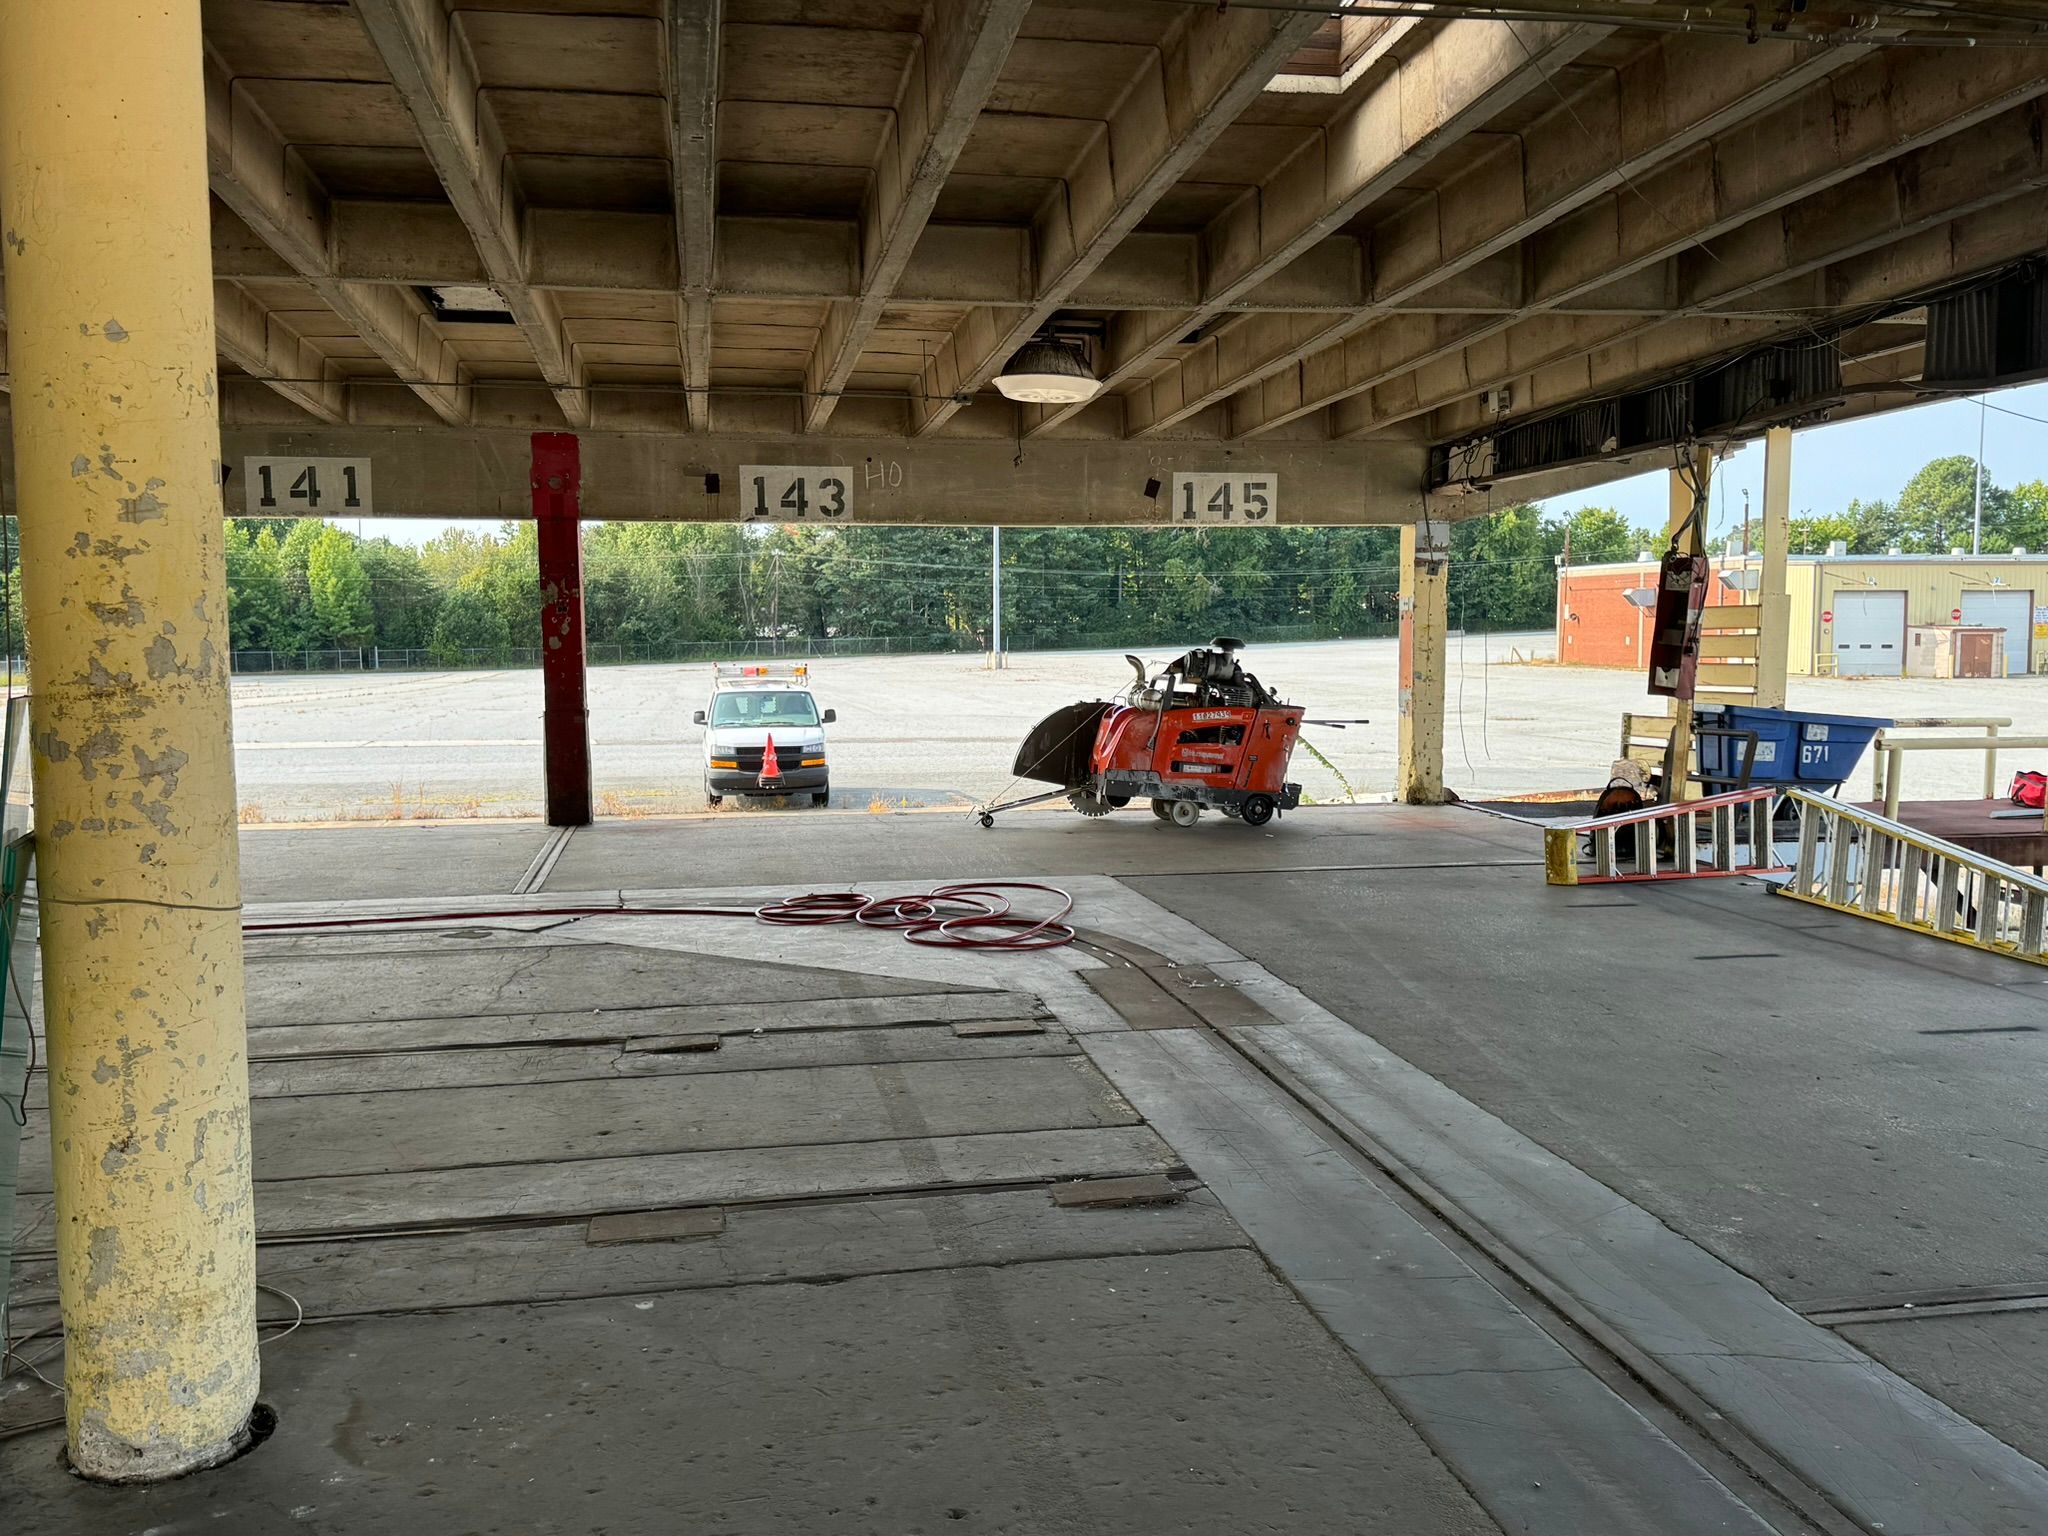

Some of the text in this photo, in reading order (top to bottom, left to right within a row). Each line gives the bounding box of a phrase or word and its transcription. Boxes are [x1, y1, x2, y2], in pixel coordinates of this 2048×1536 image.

[258, 465, 361, 507] 141
[753, 476, 846, 518] 143
[1183, 481, 1269, 520] 145
[1802, 745, 1829, 763] 671
